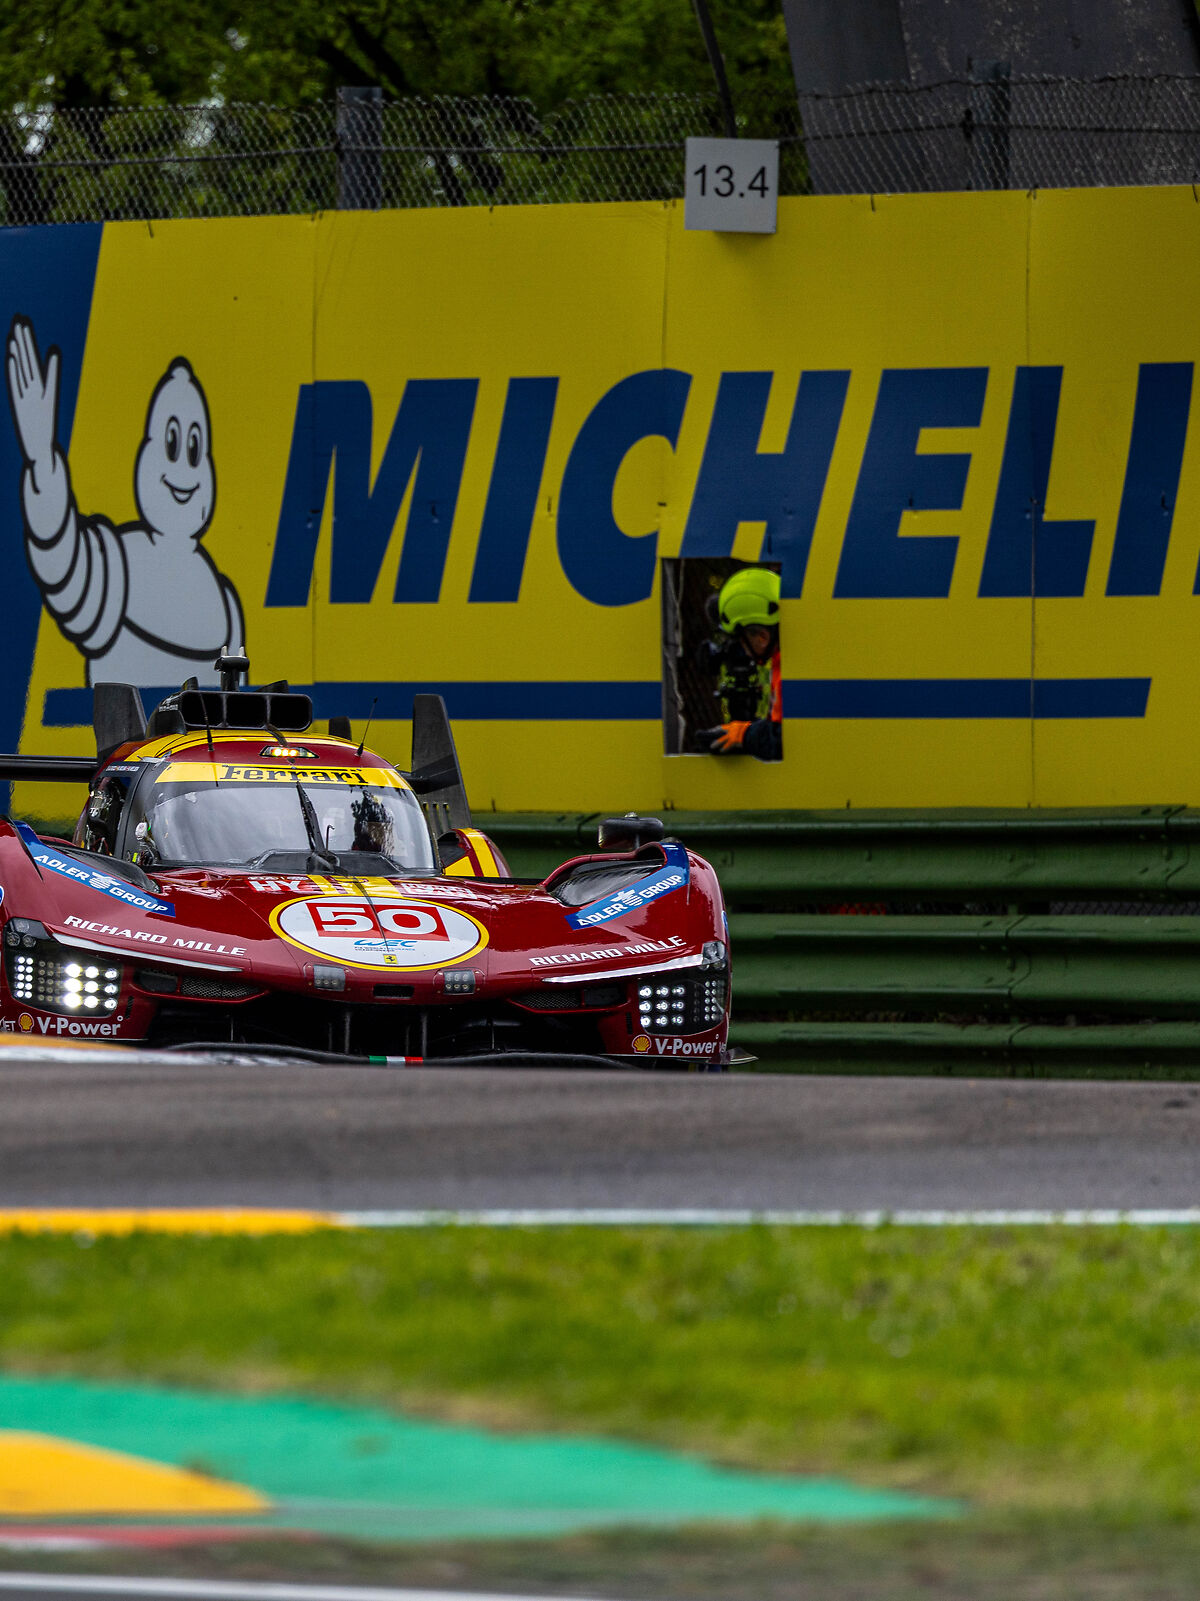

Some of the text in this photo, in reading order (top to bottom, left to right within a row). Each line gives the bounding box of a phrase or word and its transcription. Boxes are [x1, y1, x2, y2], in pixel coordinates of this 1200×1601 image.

[693, 164, 770, 198] 13.4
[264, 362, 1200, 607] MICHELI
[219, 764, 368, 784] Ferrari
[34, 854, 169, 912] ADLER GROUP
[576, 874, 682, 926] ADLER GROUP
[63, 915, 248, 956] RICHARD MILLE
[315, 905, 438, 935] 50
[354, 939, 418, 948] WEC
[529, 935, 688, 967] RICHARD MILLE
[36, 1016, 122, 1036] V-Power
[654, 1038, 717, 1055] V-Power
